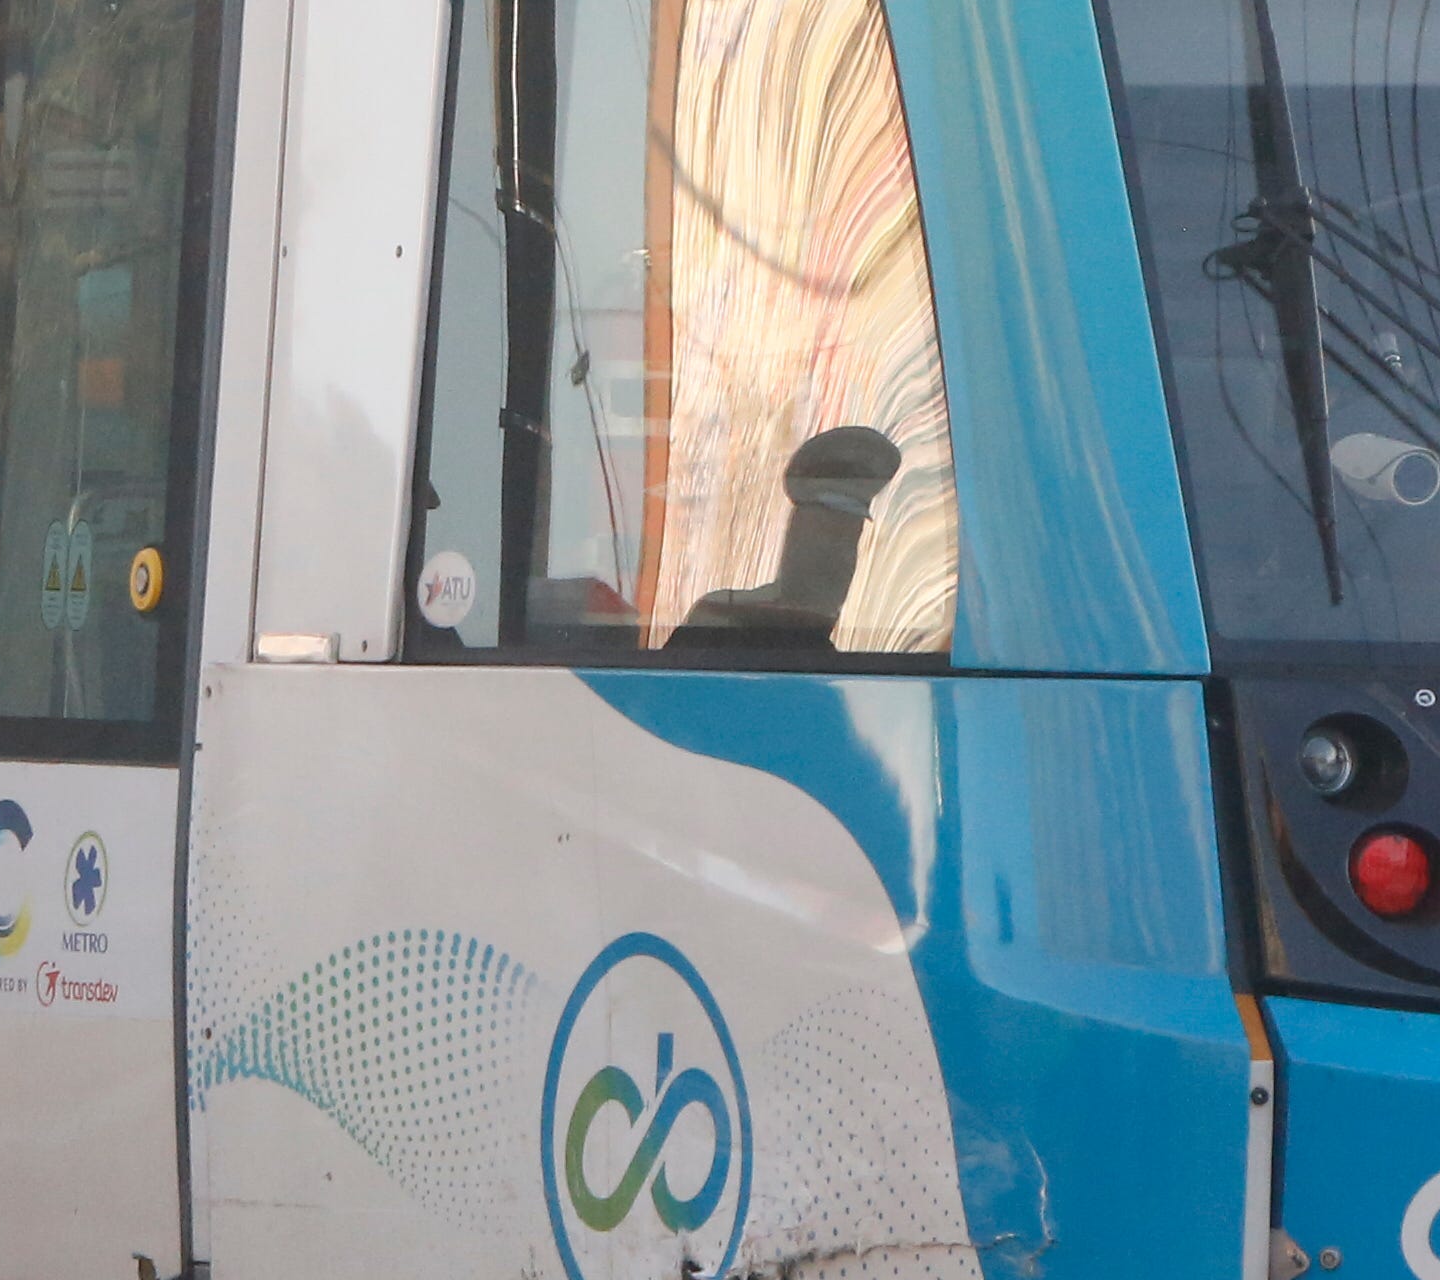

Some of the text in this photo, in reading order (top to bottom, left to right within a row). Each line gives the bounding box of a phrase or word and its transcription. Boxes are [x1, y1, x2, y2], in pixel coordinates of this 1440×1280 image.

[441, 576, 471, 600] ATU
[62, 932, 108, 954] METRO
[61, 976, 118, 1003] transdev
